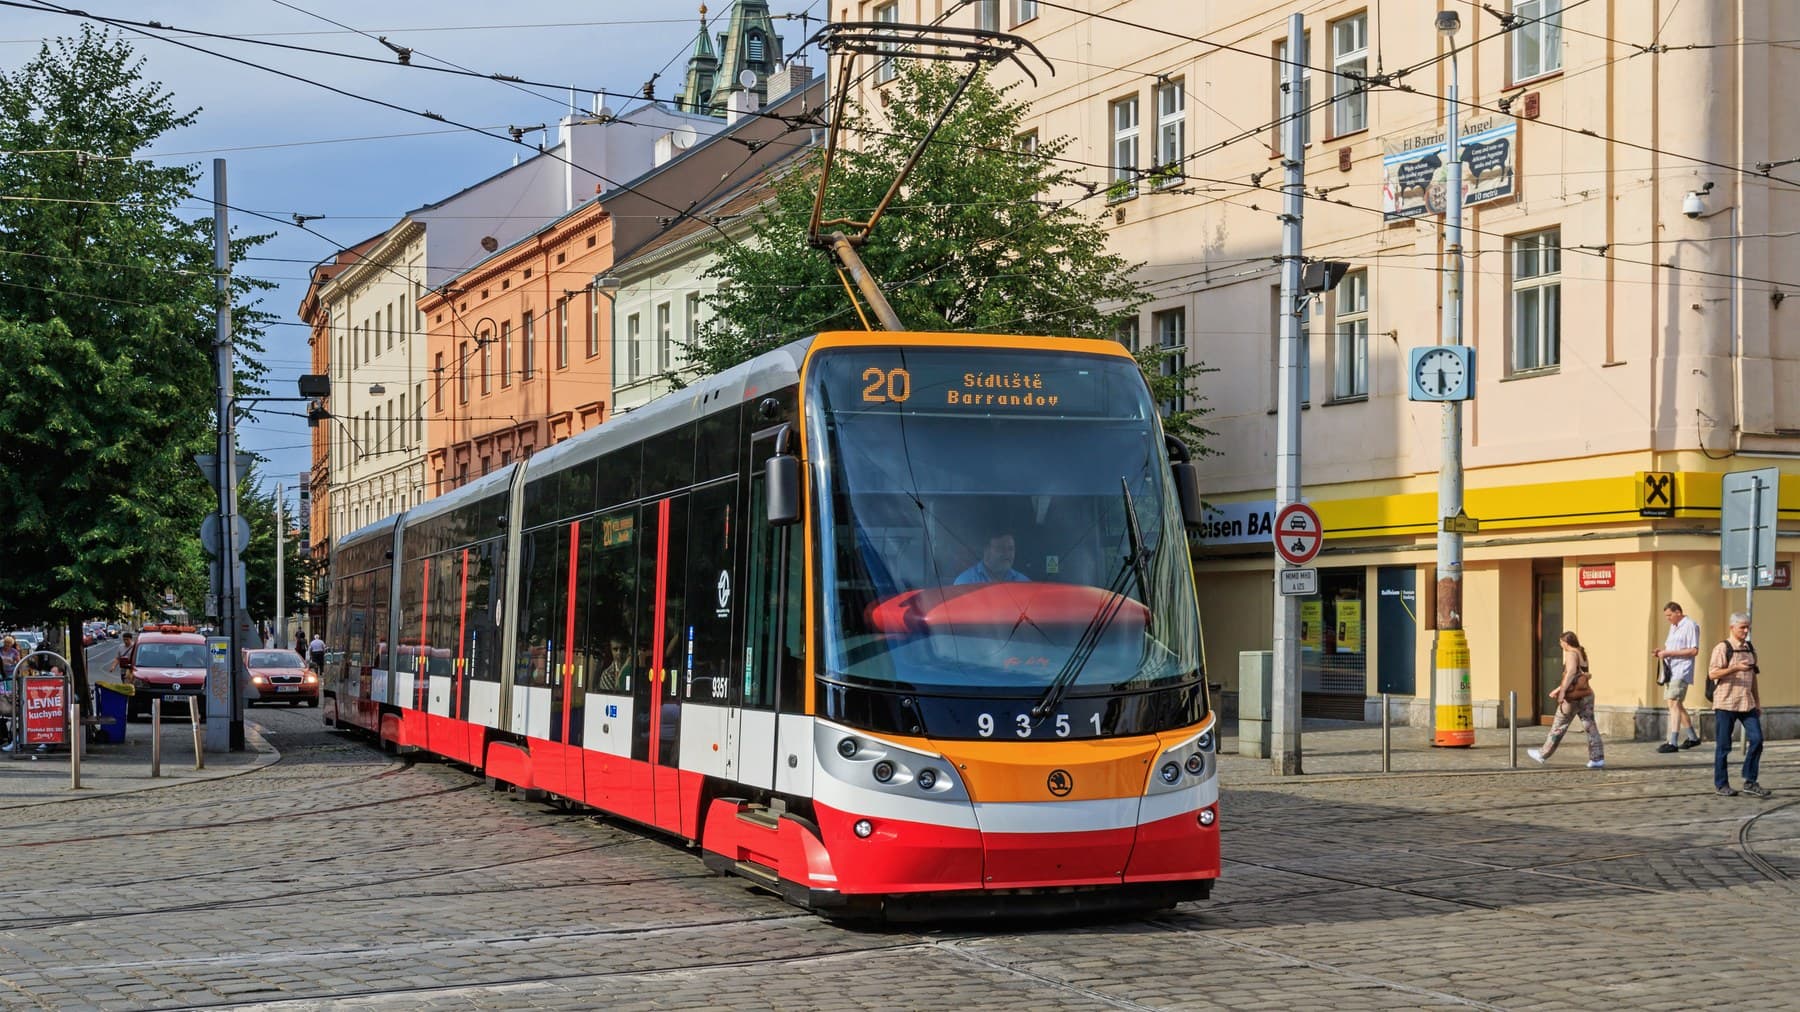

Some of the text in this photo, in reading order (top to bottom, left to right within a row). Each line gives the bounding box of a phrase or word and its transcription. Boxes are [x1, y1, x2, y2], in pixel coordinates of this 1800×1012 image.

[1403, 138, 1411, 152] El
[1415, 131, 1444, 148] Barrio
[1475, 192, 1481, 200] 10
[862, 367, 1042, 402] 20 Sídliště
[947, 390, 1058, 406] Barrandov
[1247, 511, 1277, 535] BA
[712, 677, 728, 698] 9351
